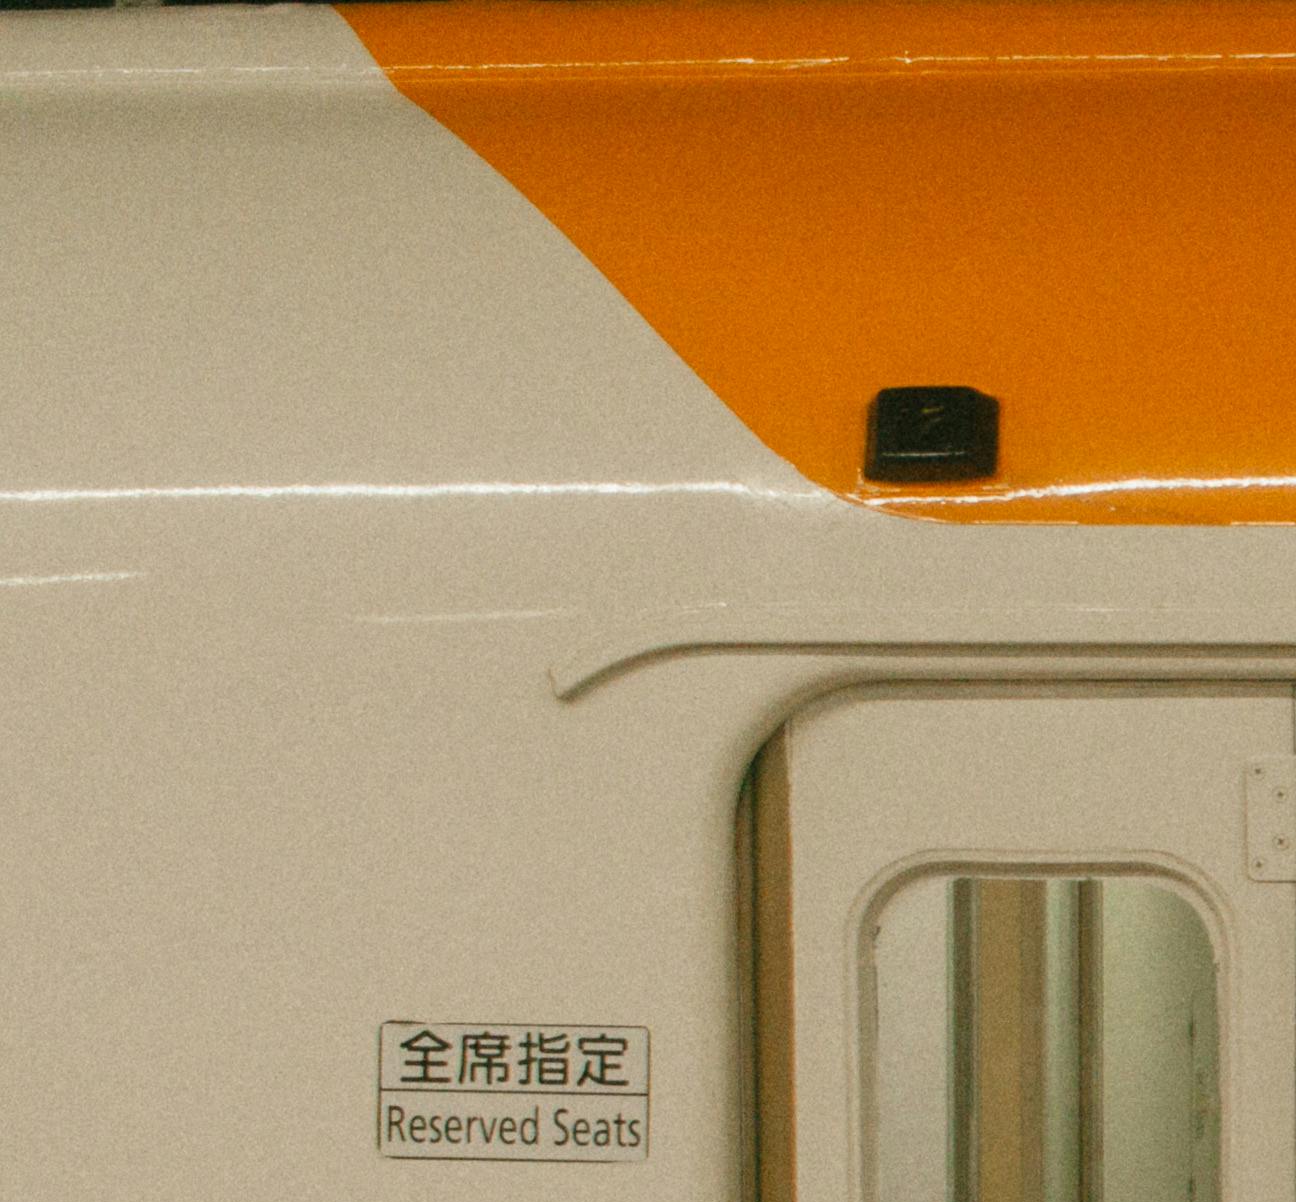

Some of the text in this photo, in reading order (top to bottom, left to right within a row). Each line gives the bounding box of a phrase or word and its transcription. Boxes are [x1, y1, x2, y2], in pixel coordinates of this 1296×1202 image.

[400, 1029, 630, 1087] 全席指定
[386, 1104, 642, 1148] Reserved Seats
